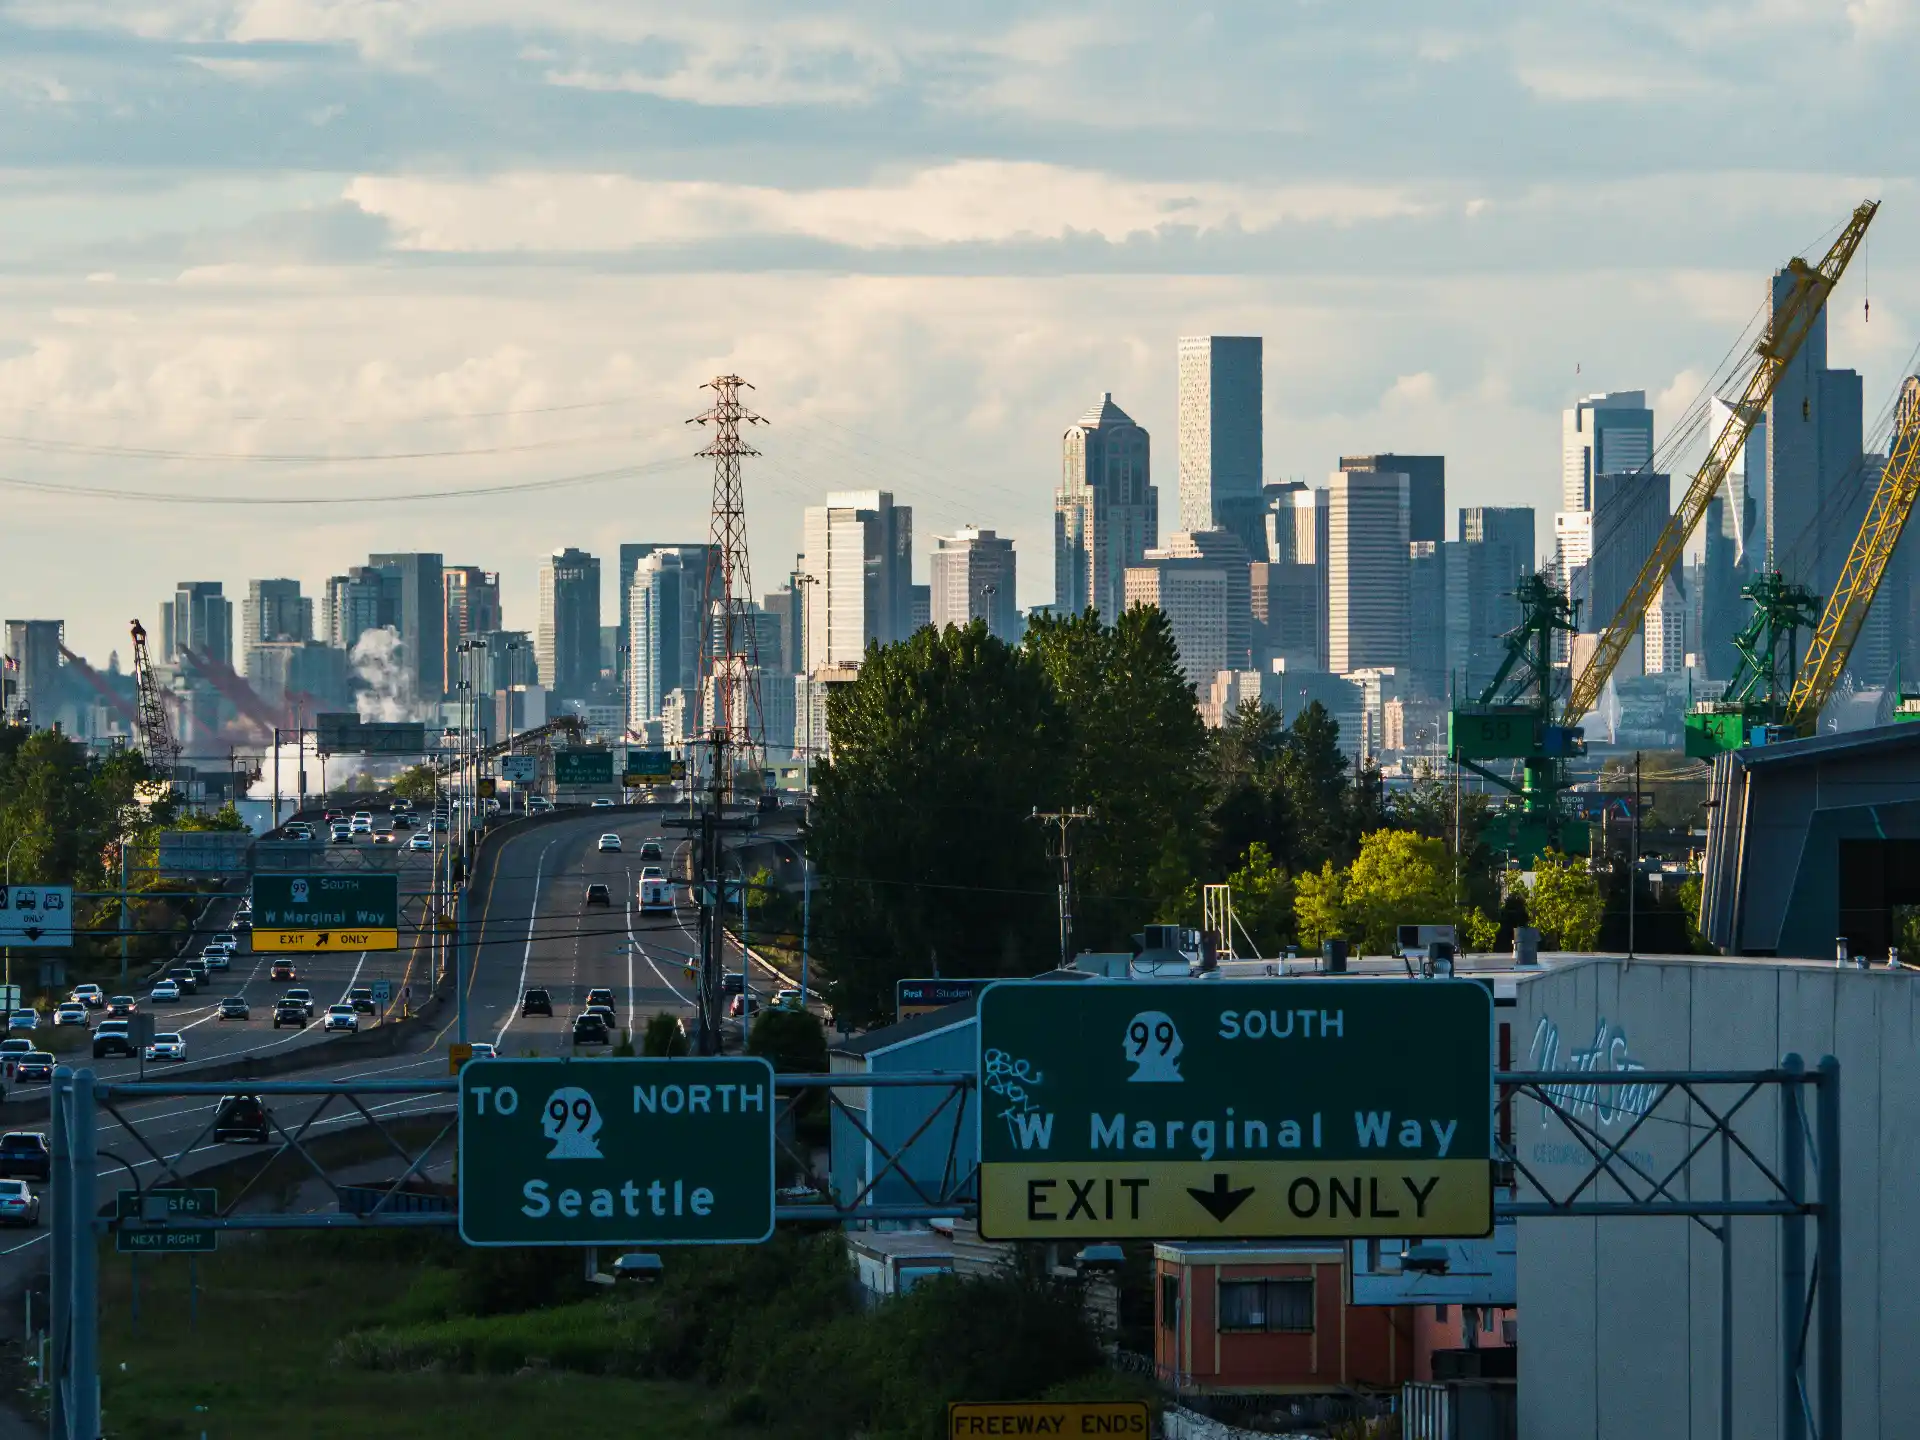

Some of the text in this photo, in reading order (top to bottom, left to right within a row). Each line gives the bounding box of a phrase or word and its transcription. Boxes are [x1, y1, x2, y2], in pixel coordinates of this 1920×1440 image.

[1703, 718, 1725, 740] 54
[293, 882, 307, 893] 99
[320, 879, 359, 889] SOUTH
[23, 913, 44, 923] ONLY
[265, 909, 385, 926] W Marginal Way
[280, 935, 369, 944] EXIT ONLY
[903, 988, 973, 998] First Student
[1218, 1009, 1344, 1039] SOUTH
[1130, 1022, 1174, 1057] 99
[470, 1086, 519, 1116] TO
[633, 1084, 764, 1114] NORTH
[549, 1098, 592, 1135] 99
[1017, 1107, 1459, 1160] W Marginal Way
[520, 1179, 715, 1218] Seattle
[1028, 1176, 1440, 1221] EXIT ONLY
[130, 1233, 202, 1246] NEXT RIGHT
[955, 1414, 1144, 1435] FREEWAY ENDS
